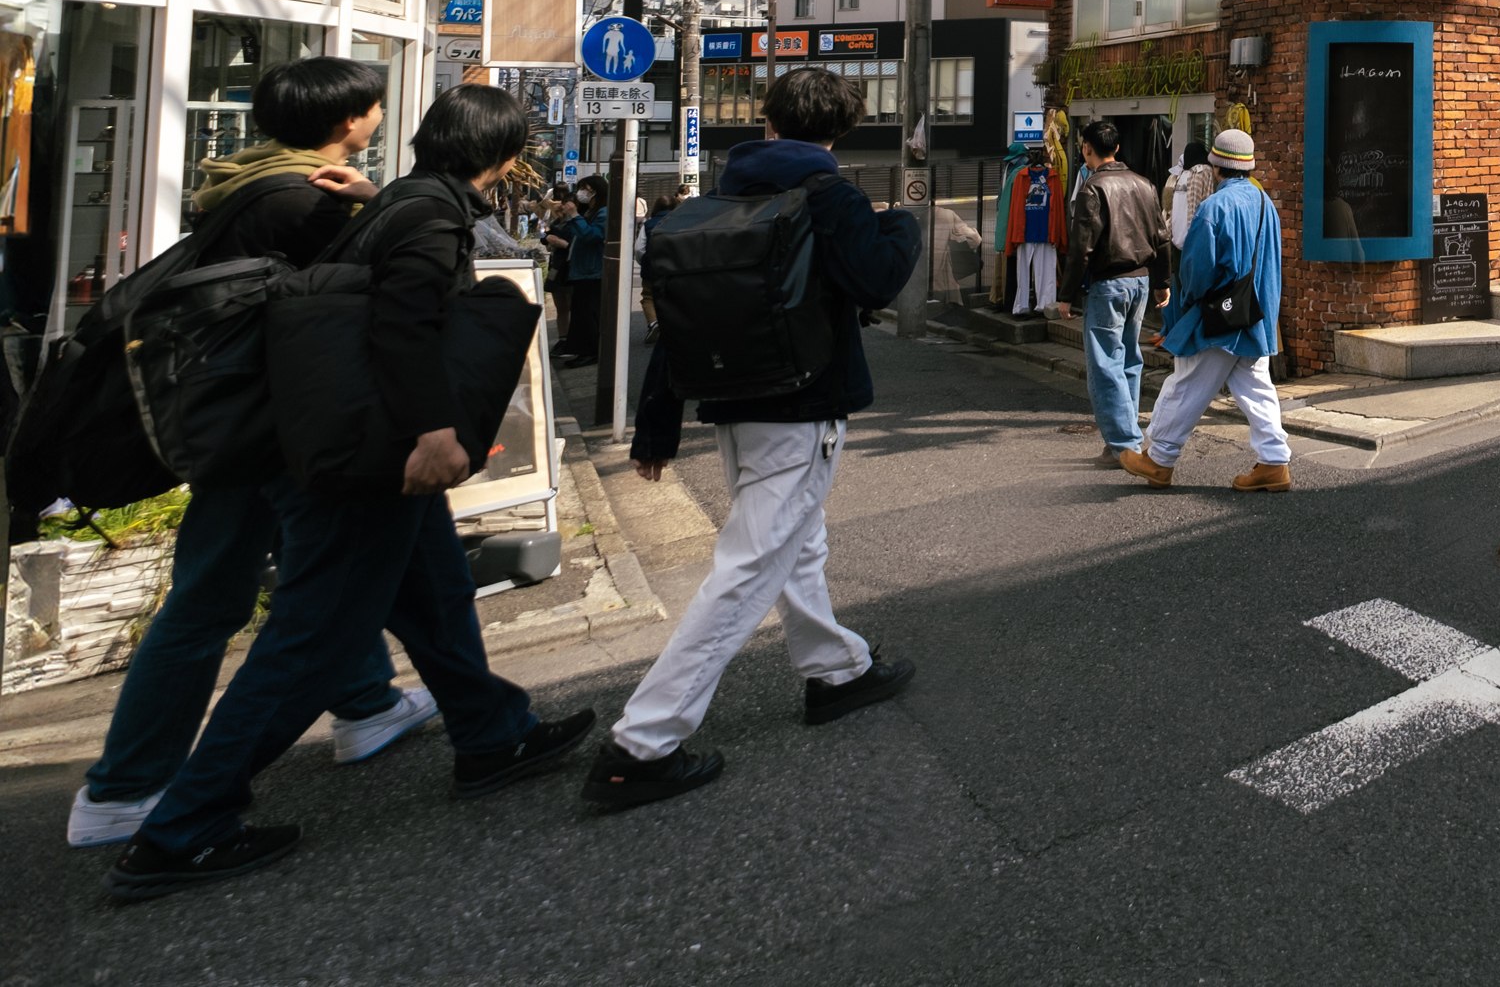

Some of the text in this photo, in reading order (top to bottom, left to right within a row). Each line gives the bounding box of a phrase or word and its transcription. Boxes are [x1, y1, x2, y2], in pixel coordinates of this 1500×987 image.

[708, 41, 736, 50] 横浜銀行
[848, 41, 873, 49] Coffee
[583, 86, 650, 100] 自転車を除く
[586, 101, 601, 114] 13
[632, 102, 645, 115] 18
[1433, 225, 1449, 235] epair
